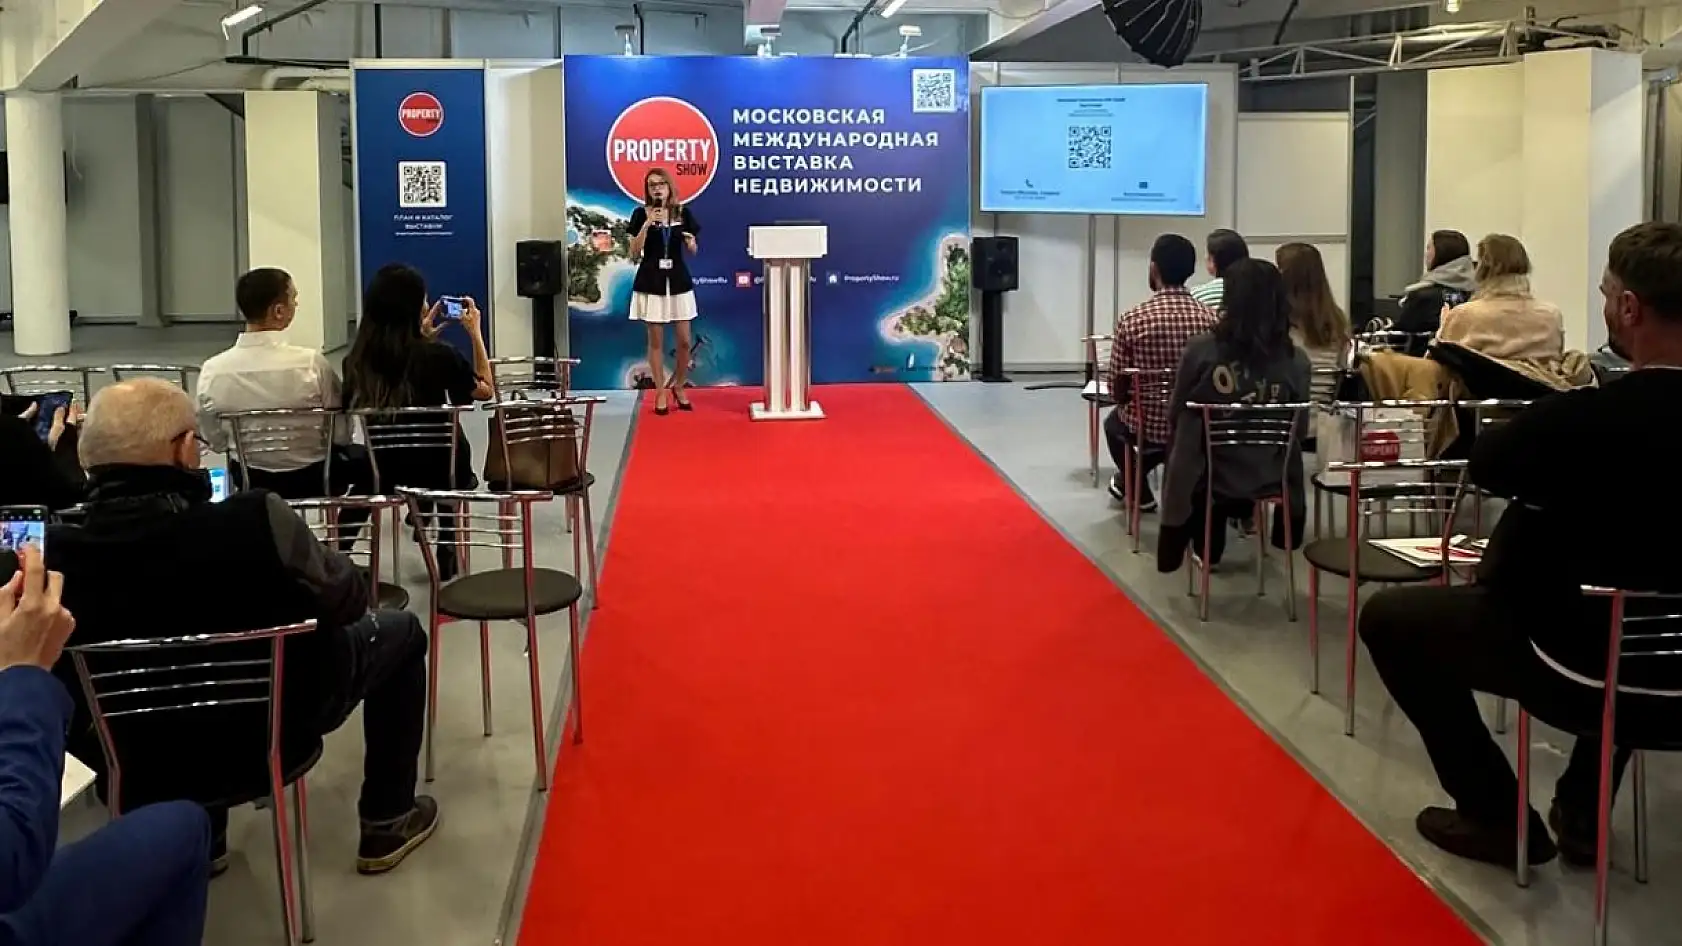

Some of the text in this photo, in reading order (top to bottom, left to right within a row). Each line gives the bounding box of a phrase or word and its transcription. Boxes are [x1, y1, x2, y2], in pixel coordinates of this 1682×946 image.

[402, 108, 440, 119] PROPERTY
[732, 108, 886, 125] МОСКОВСКАЯ
[732, 131, 940, 149] МЕЖДУНАРОДНАЯ
[613, 138, 711, 162] PROPERTY
[676, 163, 708, 177] SHOW
[733, 154, 854, 171] ВЫСТАВКА
[733, 177, 922, 195] НЕДВИЖИМОСТИ
